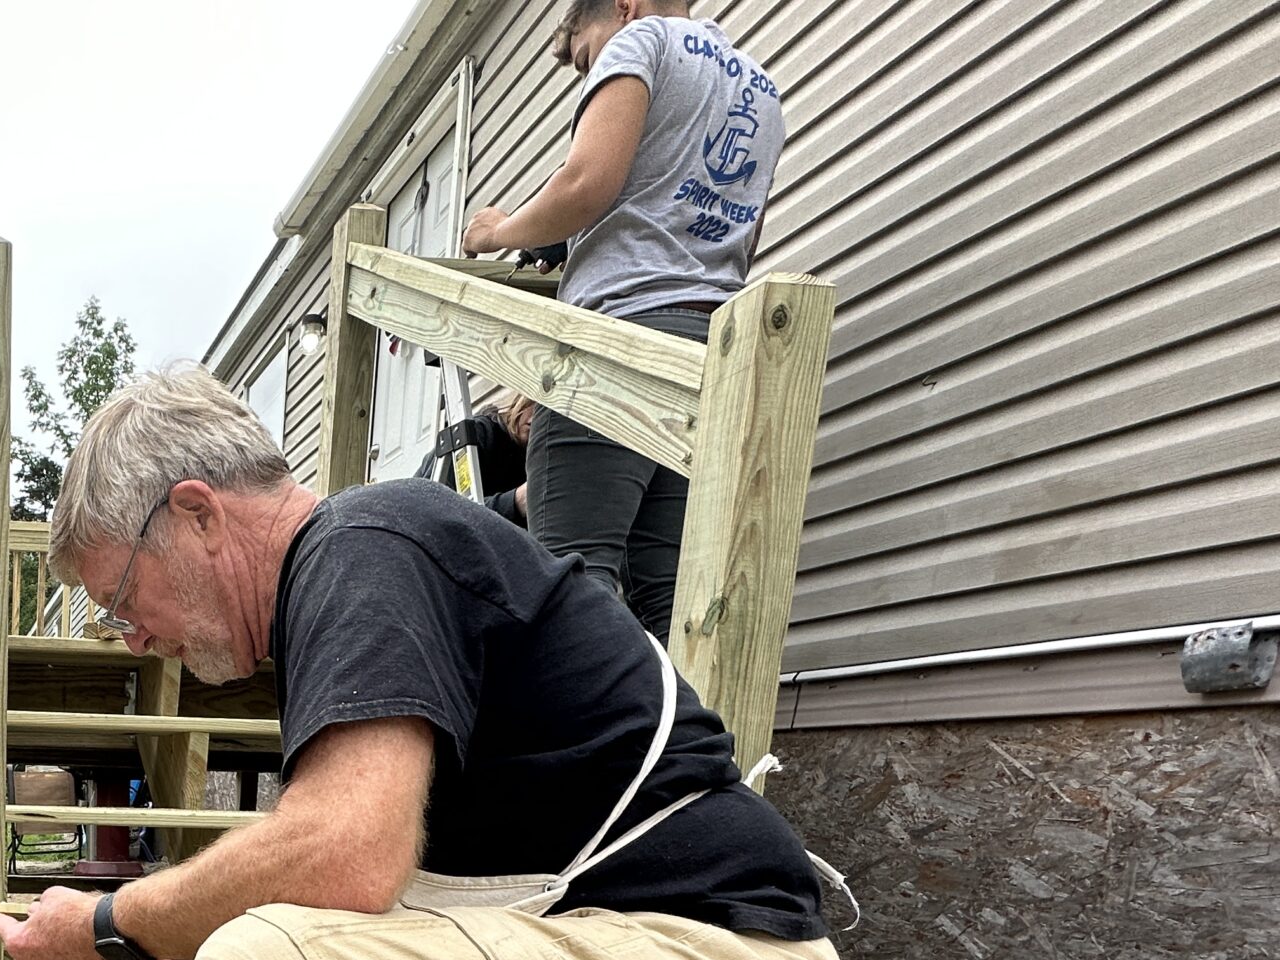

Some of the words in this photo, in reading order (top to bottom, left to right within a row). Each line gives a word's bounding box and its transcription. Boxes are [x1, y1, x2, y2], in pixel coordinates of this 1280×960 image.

[683, 34, 725, 67] CLA
[726, 57, 743, 77] O
[750, 68, 778, 99] 202
[673, 177, 721, 212] SPIRIT
[720, 198, 759, 224] WEEK
[686, 212, 730, 242] 2022
